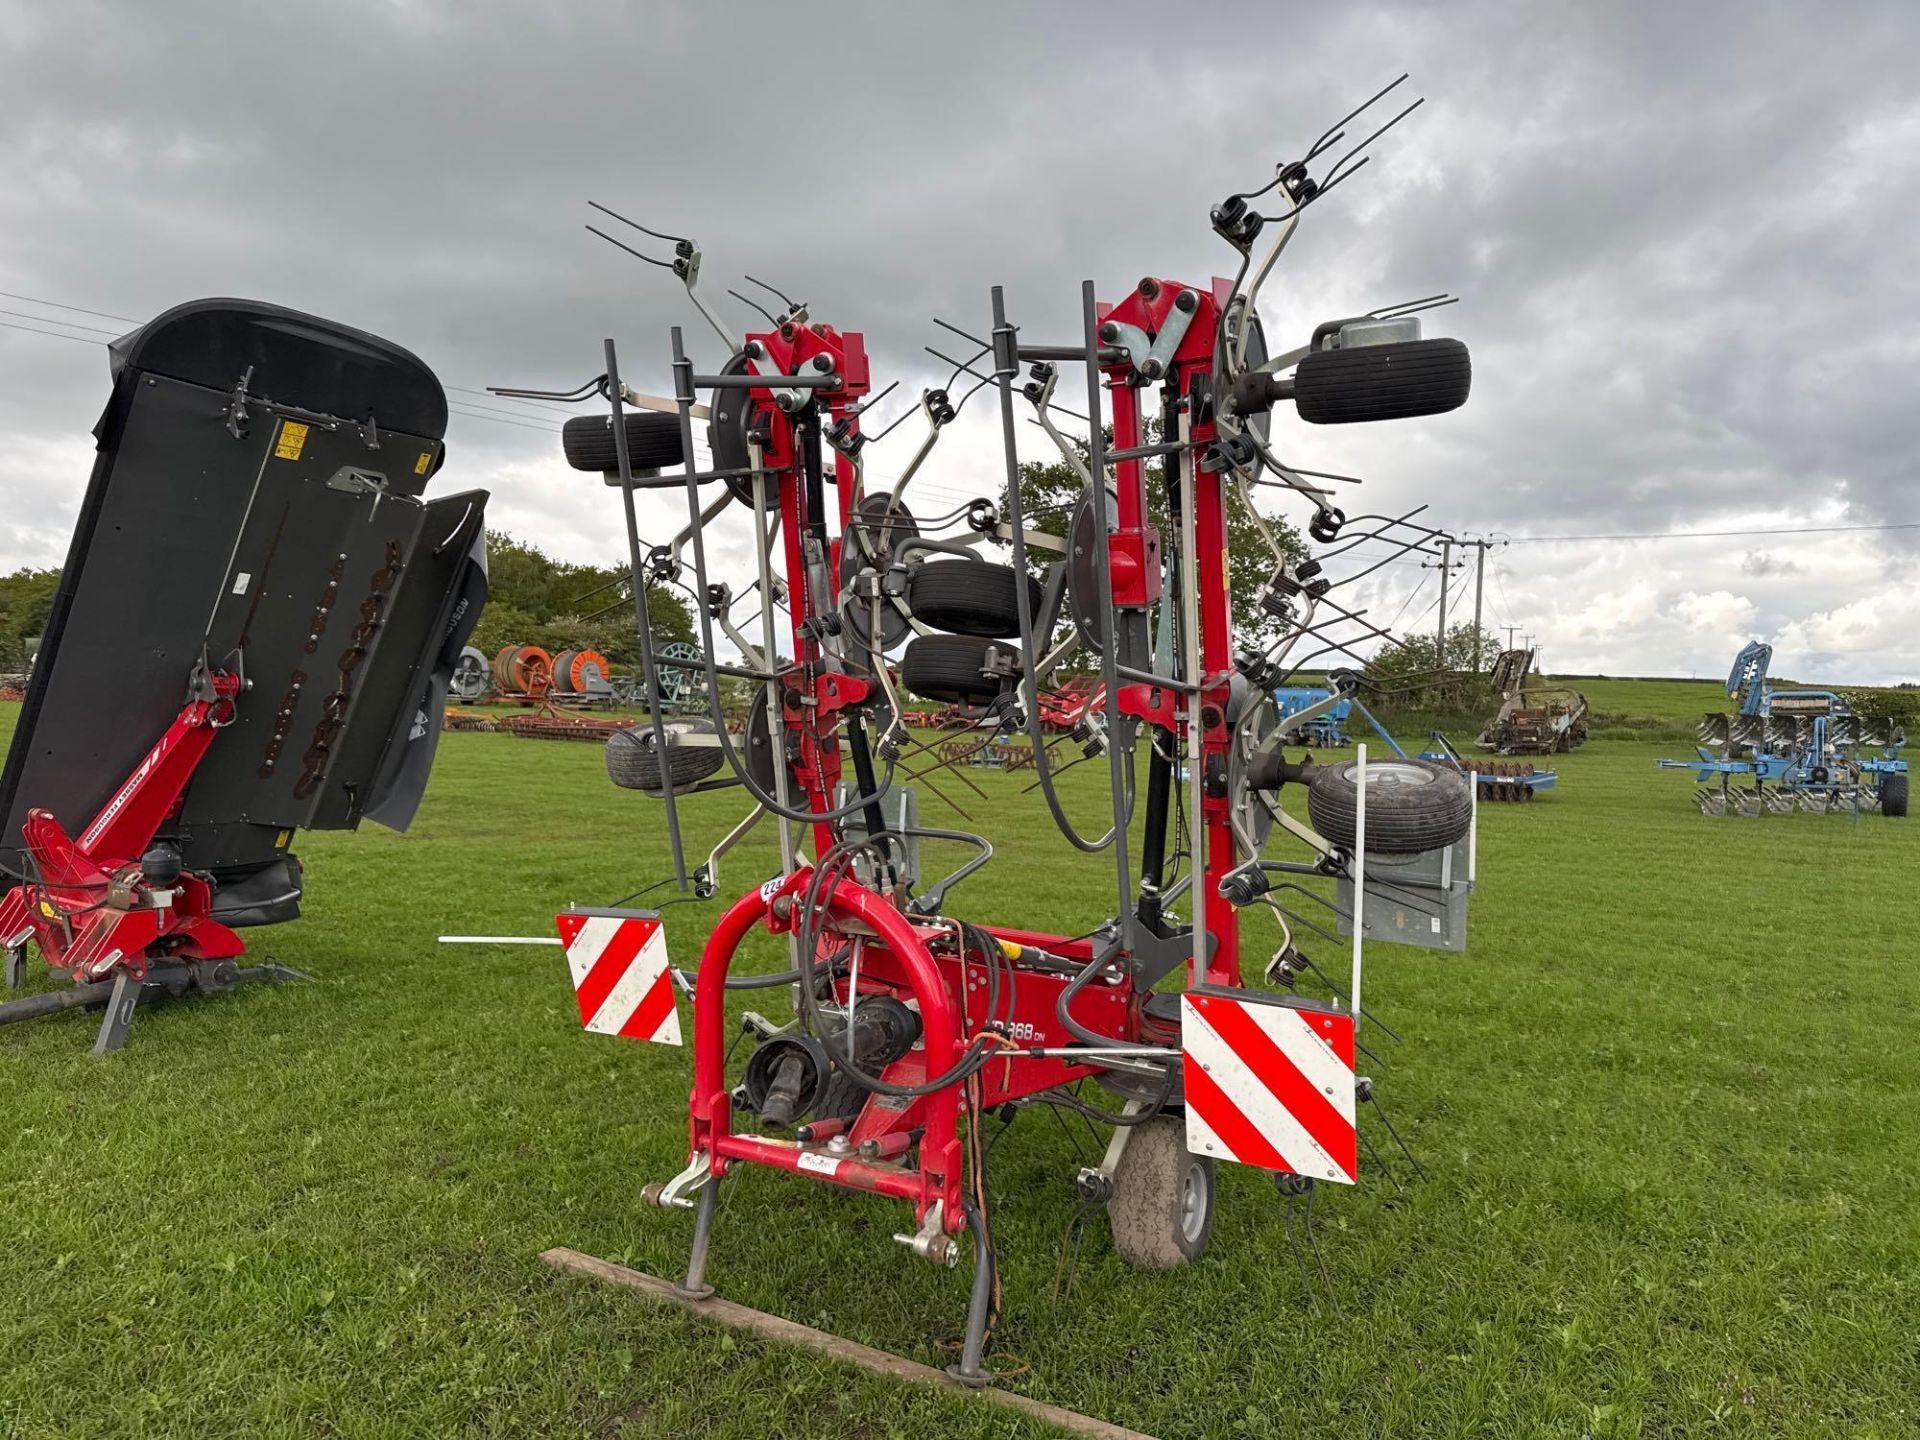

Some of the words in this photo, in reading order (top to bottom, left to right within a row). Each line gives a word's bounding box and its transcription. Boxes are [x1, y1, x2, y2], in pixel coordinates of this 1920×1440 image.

[118, 773, 143, 803] MASSEY
[86, 804, 118, 843] FERGUSON
[1008, 1021, 1034, 1041] 368
